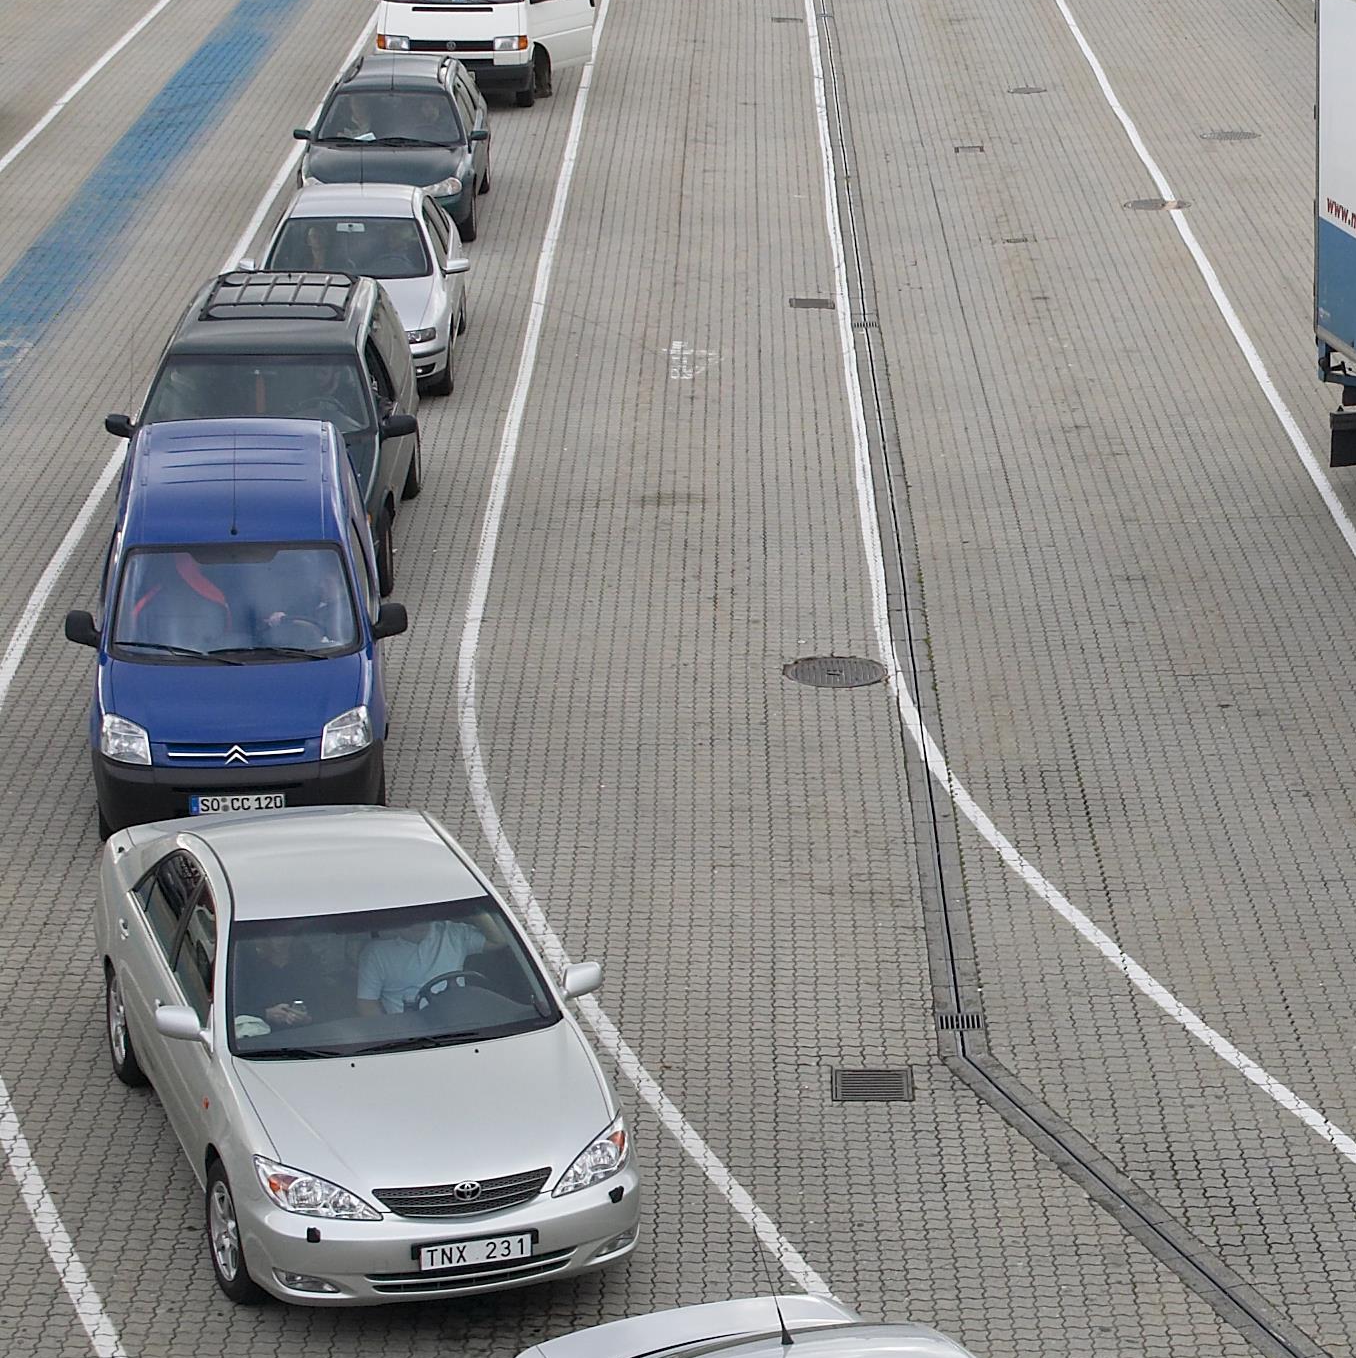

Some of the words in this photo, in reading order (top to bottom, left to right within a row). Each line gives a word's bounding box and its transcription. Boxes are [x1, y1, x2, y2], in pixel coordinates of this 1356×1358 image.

[200, 798, 220, 812] SO
[230, 797, 251, 811] CC
[254, 795, 283, 810] 120
[426, 1245, 467, 1267] TNX
[485, 1237, 525, 1260] 231
